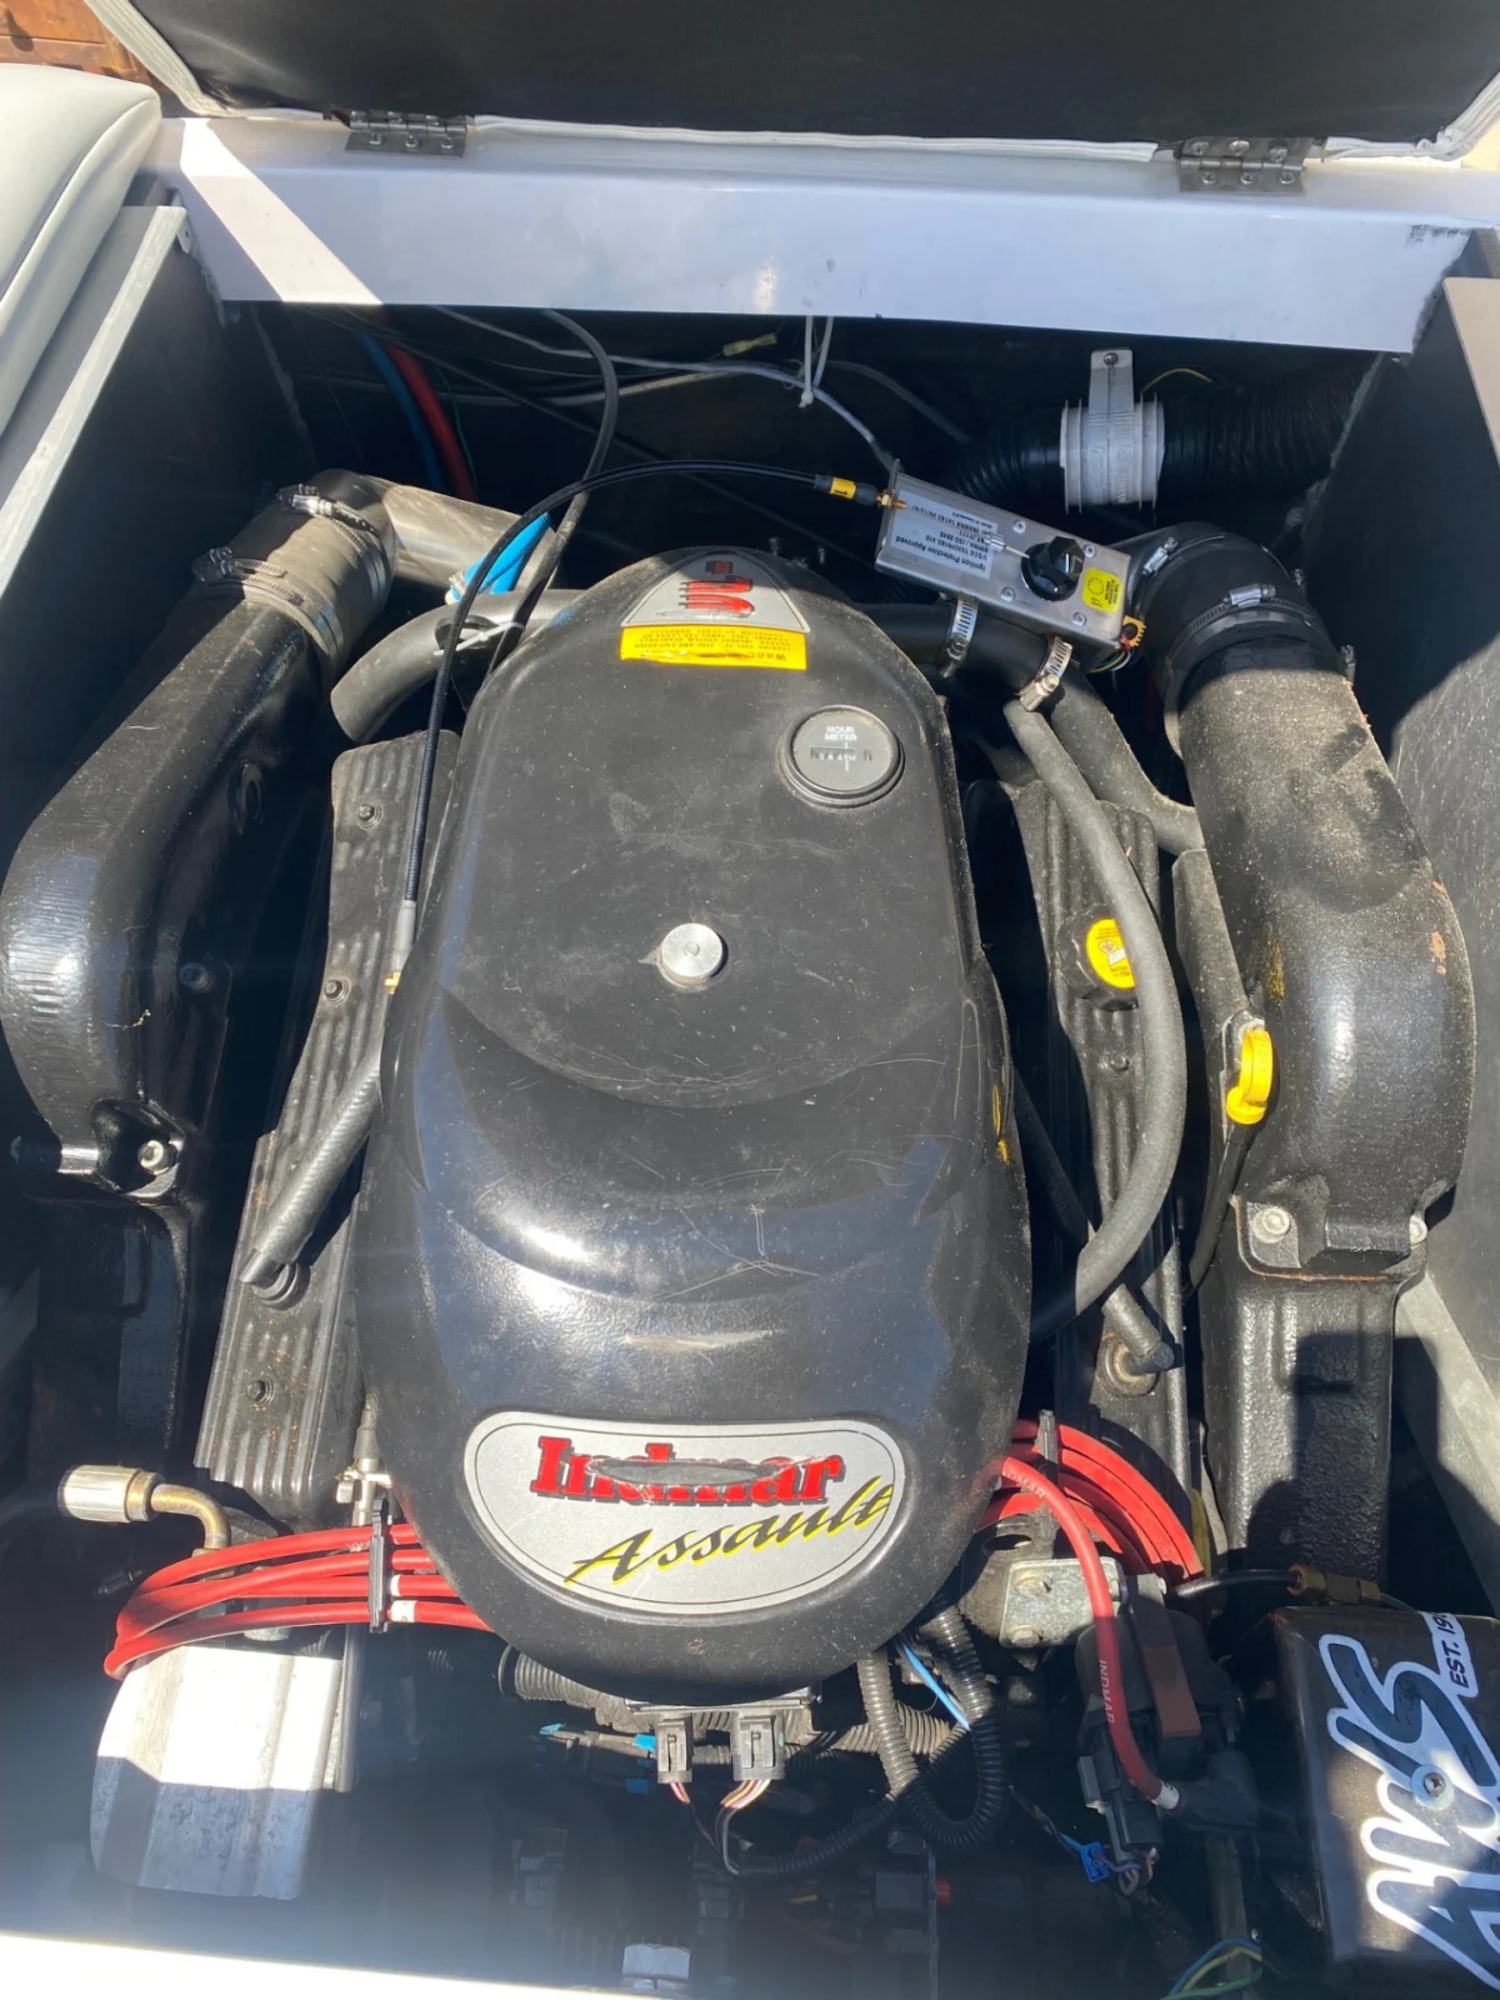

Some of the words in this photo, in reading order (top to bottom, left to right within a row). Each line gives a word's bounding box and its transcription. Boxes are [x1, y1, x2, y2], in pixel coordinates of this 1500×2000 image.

[895, 535, 927, 551] Approved
[927, 546, 961, 563] Protection
[961, 558, 986, 572] Ignition
[824, 733, 857, 741] METER
[562, 1474, 895, 1586] Assault
[1432, 1612, 1456, 1635] 19
[1441, 1639, 1470, 1689] EST.
[1099, 1659, 1115, 1724] INDMAR
